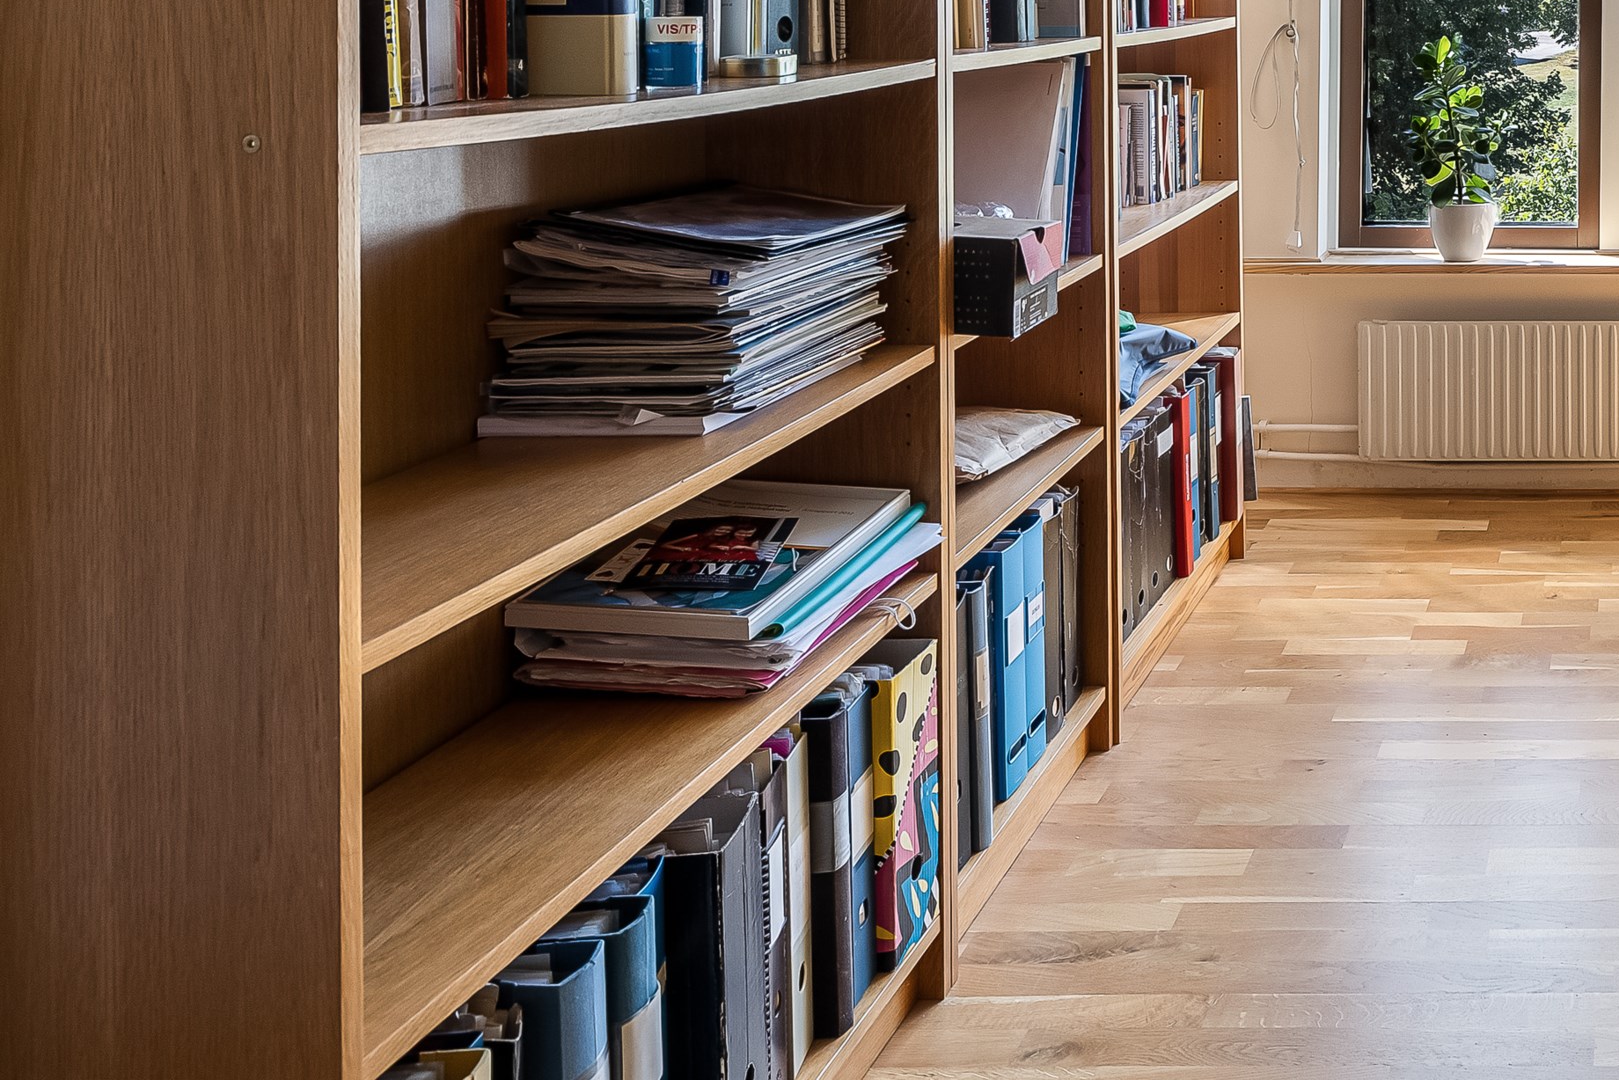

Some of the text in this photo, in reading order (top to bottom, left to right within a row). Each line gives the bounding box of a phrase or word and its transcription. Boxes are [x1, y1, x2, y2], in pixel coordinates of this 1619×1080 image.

[657, 24, 701, 35] VIS/TP
[518, 59, 524, 71] 4
[637, 562, 761, 577] HOME
